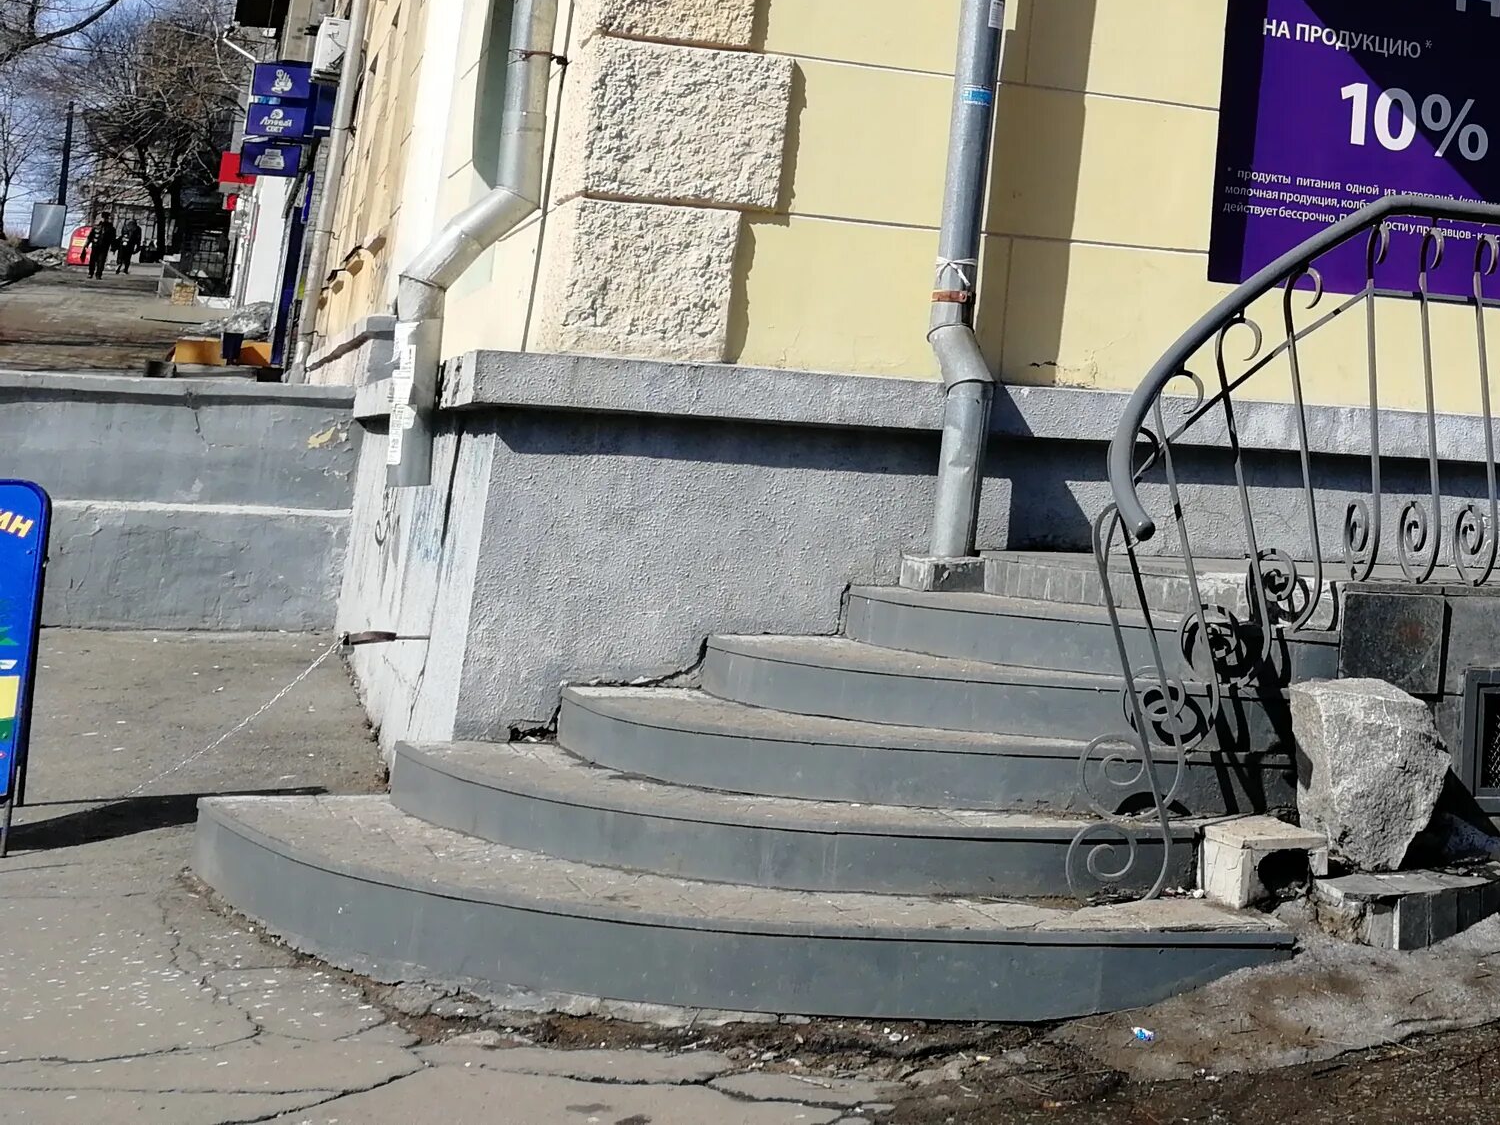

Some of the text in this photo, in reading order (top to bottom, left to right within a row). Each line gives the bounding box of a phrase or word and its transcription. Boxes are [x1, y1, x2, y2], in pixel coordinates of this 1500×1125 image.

[1263, 18, 1291, 41] НА
[1340, 82, 1489, 162] 10%
[1225, 184, 1279, 200] молочная
[1238, 169, 1291, 185] продукты
[1296, 175, 1341, 191] питания
[1345, 182, 1380, 196] одной
[1223, 201, 1278, 217] действует
